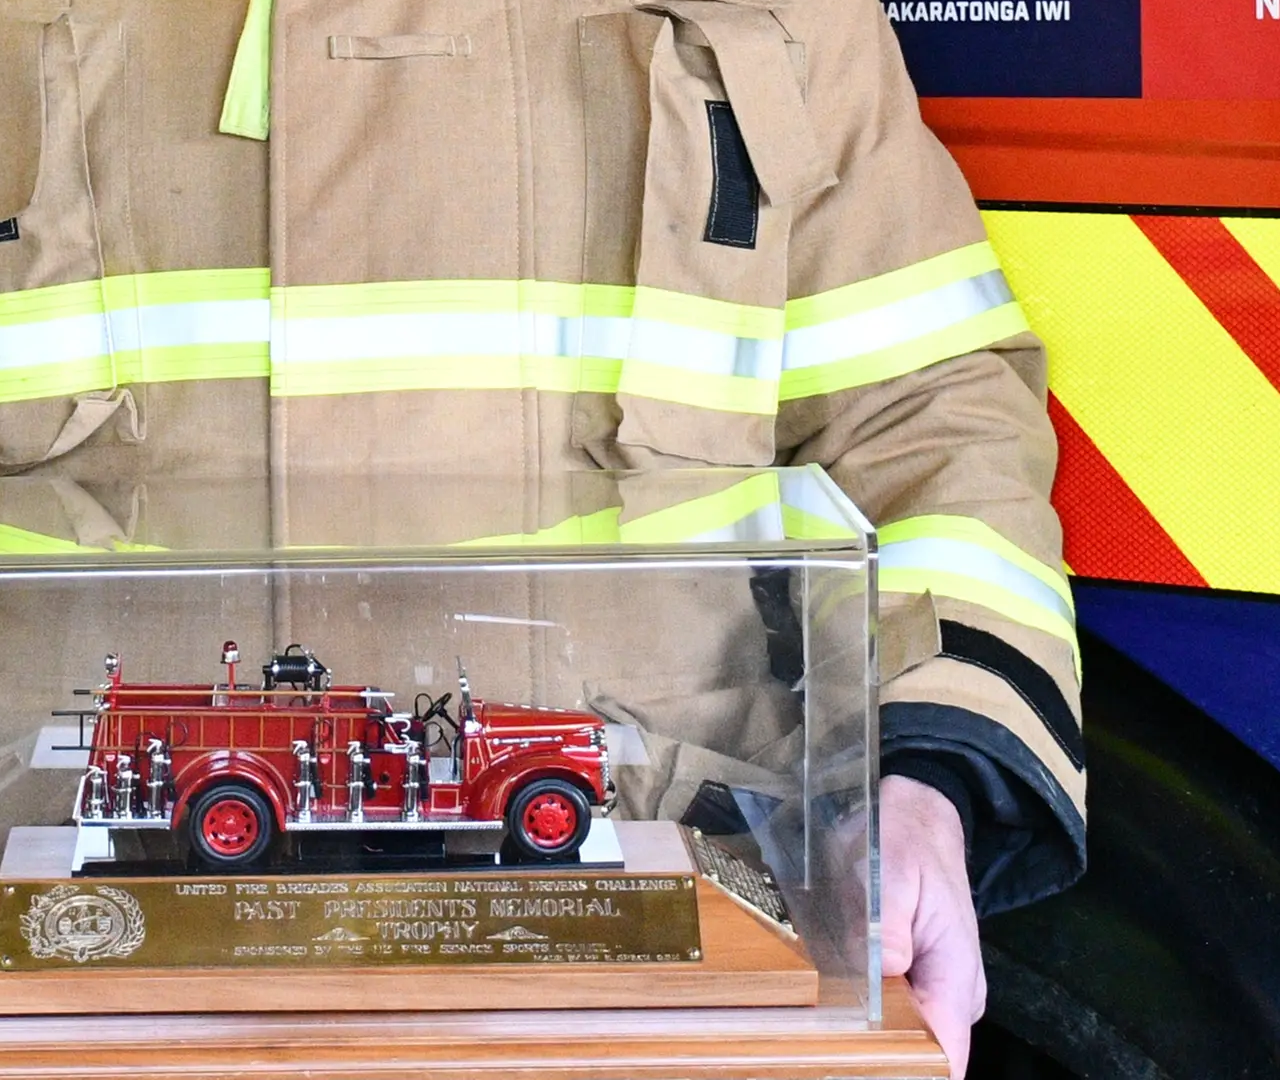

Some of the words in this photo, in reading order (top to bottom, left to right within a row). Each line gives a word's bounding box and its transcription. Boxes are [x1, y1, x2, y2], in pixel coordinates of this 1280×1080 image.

[1035, 0, 1070, 21] IWI
[176, 883, 227, 895] UNITED
[235, 883, 268, 895] FIRE
[276, 882, 349, 895] BRIGADES
[355, 881, 447, 894] ASSOCIATION
[454, 880, 523, 892] NATIONAL
[529, 880, 588, 891] DRIVERS
[595, 879, 679, 891] CHALLENGE
[234, 899, 301, 920] PAST
[324, 898, 477, 919] PRESIDENTS
[489, 897, 621, 918] MEMORIAL
[375, 920, 480, 941] TROPHY
[234, 945, 308, 956] SPONSORED
[314, 945, 333, 955] BY
[401, 944, 432, 954] FIRE
[439, 943, 494, 954] SERVICE
[503, 942, 550, 954] SPORTS
[556, 942, 611, 953] COUNCIL
